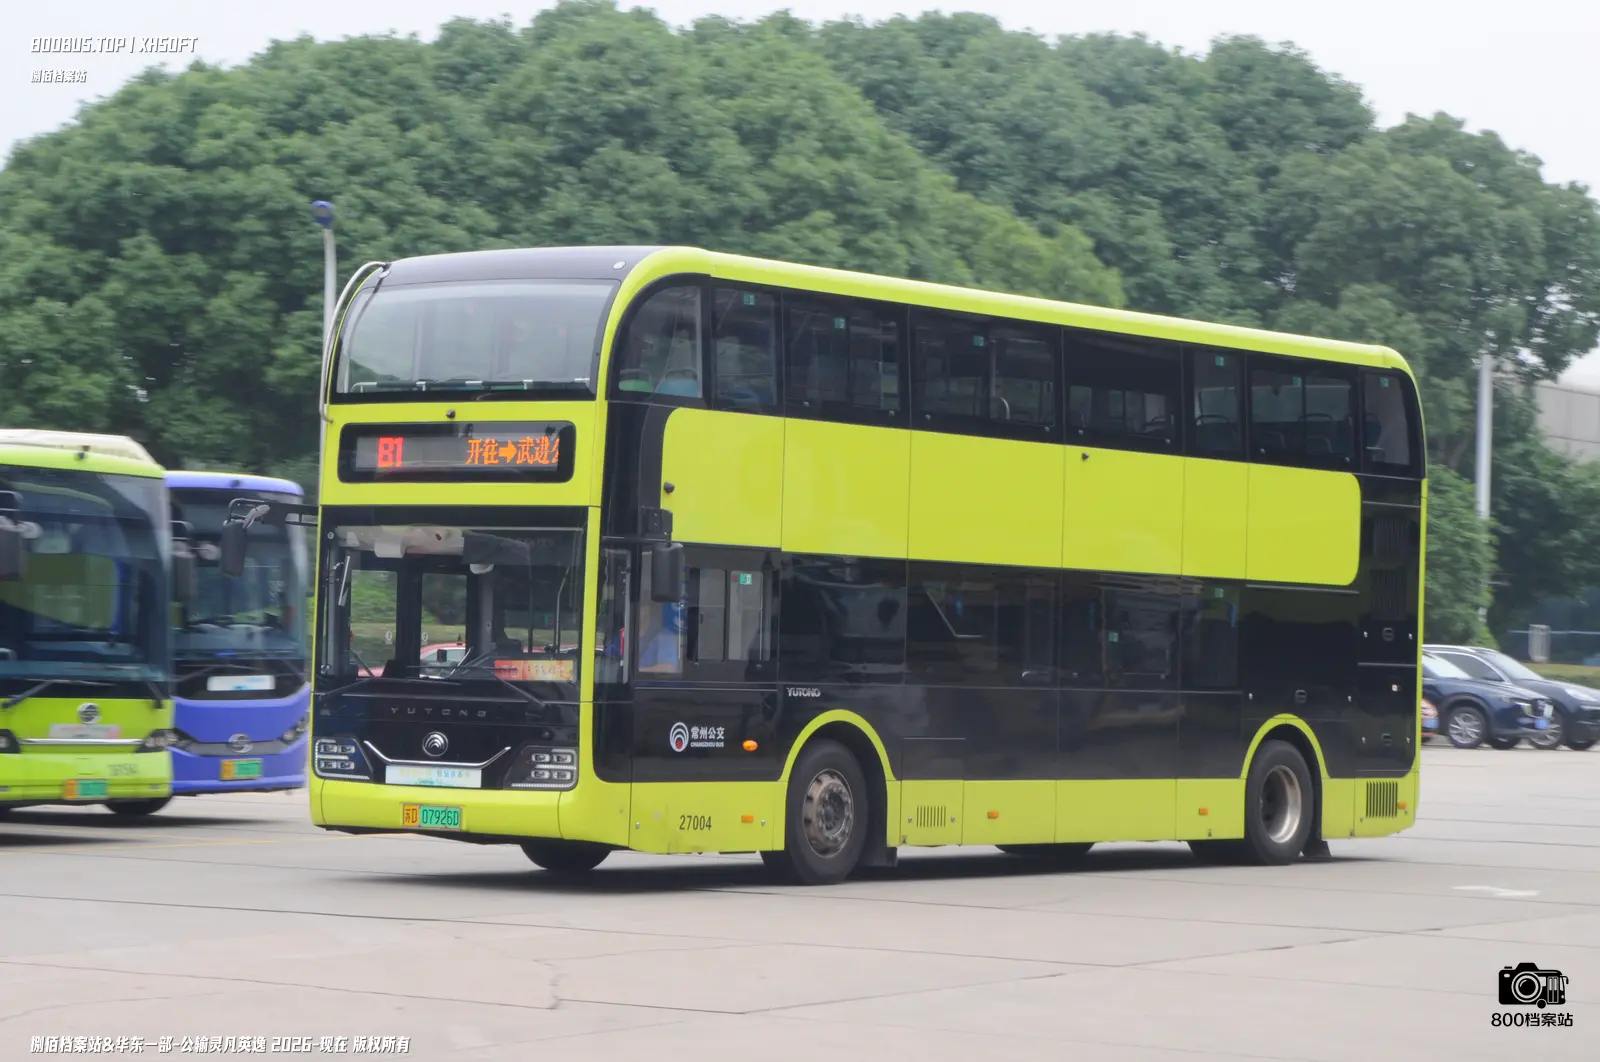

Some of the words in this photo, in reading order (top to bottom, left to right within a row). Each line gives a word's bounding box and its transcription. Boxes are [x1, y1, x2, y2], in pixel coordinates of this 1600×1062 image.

[376, 436, 404, 468] B1
[786, 687, 821, 698] YUTONG
[390, 707, 487, 718] YUTONG
[690, 725, 725, 740] 常州公交
[679, 815, 712, 831] 27004
